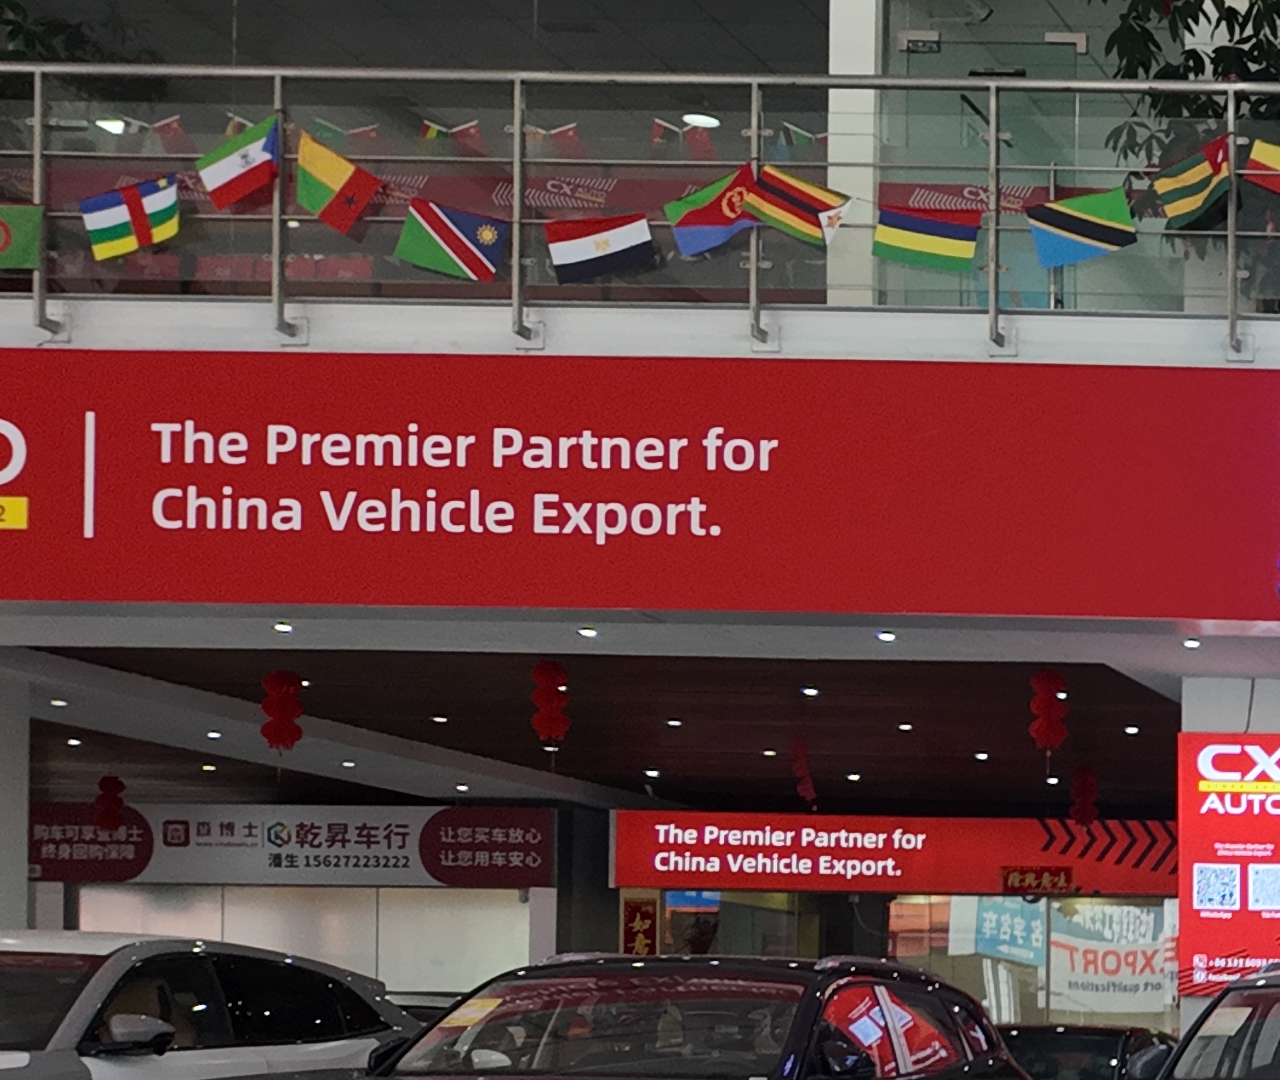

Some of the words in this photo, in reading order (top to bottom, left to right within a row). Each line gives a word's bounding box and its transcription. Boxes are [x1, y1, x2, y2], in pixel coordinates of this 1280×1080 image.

[151, 420, 249, 465] The
[267, 423, 476, 468] Premier
[493, 428, 689, 471] Partner
[703, 427, 779, 472] for
[152, 486, 302, 531] China
[319, 489, 515, 534] Vehicle
[533, 494, 721, 545] Export.
[439, 825, 543, 845] 让您买车放心
[654, 823, 698, 845] The
[704, 825, 796, 847] Premier
[801, 827, 888, 849] Partner
[891, 828, 927, 850] for
[303, 854, 411, 869] 15627223222
[439, 850, 543, 868] 让您用车安心
[654, 850, 721, 872] China
[726, 852, 813, 875] Vehicle
[818, 855, 902, 880] Export.
